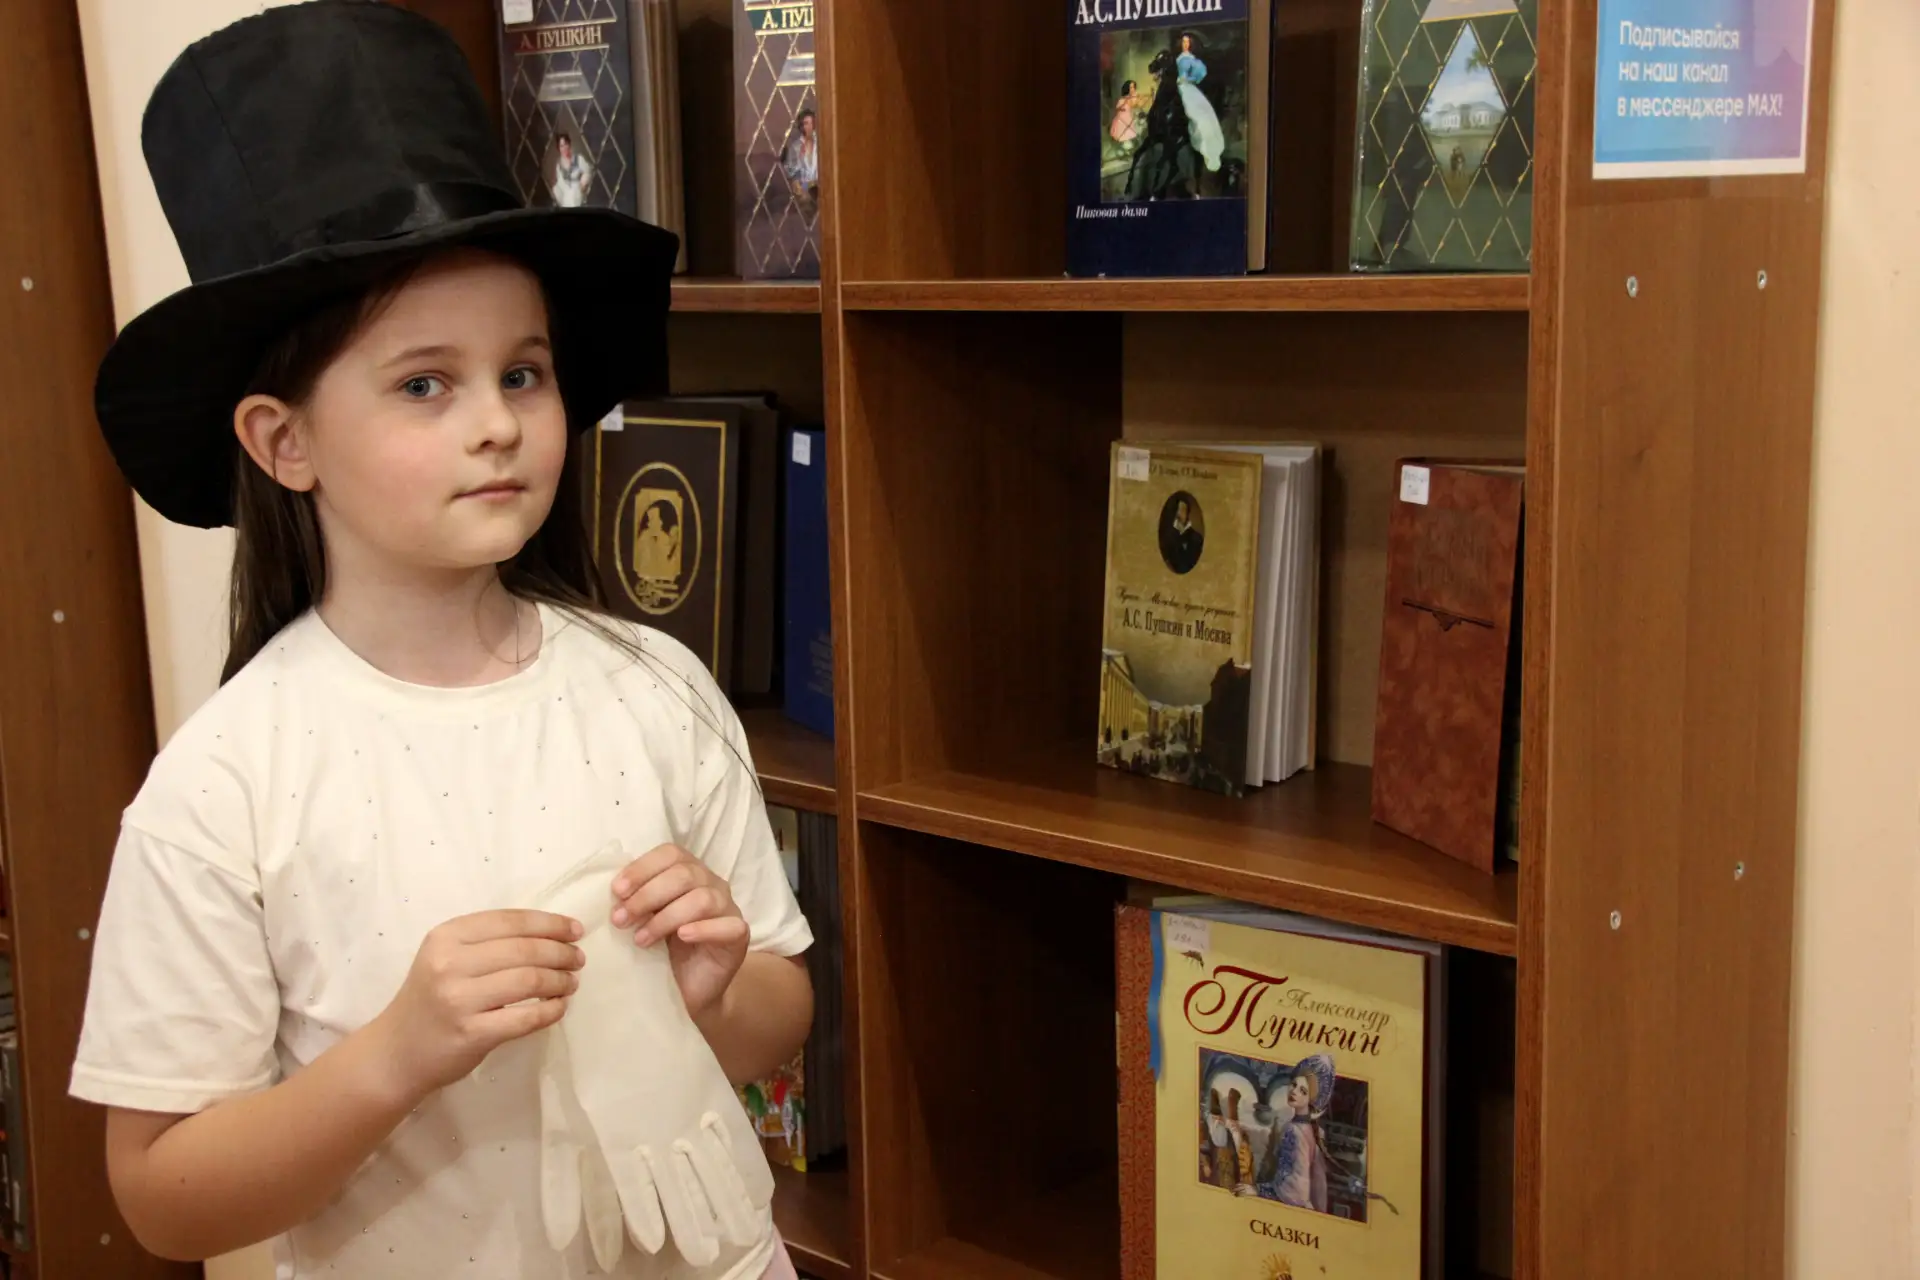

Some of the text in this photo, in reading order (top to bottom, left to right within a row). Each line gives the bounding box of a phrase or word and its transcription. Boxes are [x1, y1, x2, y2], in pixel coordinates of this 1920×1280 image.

[762, 11, 779, 30] А.
[1619, 20, 1740, 51] Подписывайся
[536, 26, 601, 49] ПУШКИН
[1618, 61, 1728, 84] на наш канал
[1617, 93, 1783, 124] в мессенджере MAX!
[1075, 204, 1148, 219] Пиковая дама
[1123, 608, 1232, 645] А.С. Пушкин и Москва
[1183, 965, 1381, 1056] Пушкин
[1277, 988, 1390, 1033] Александр
[1249, 1218, 1320, 1249] СКАЗКИ
